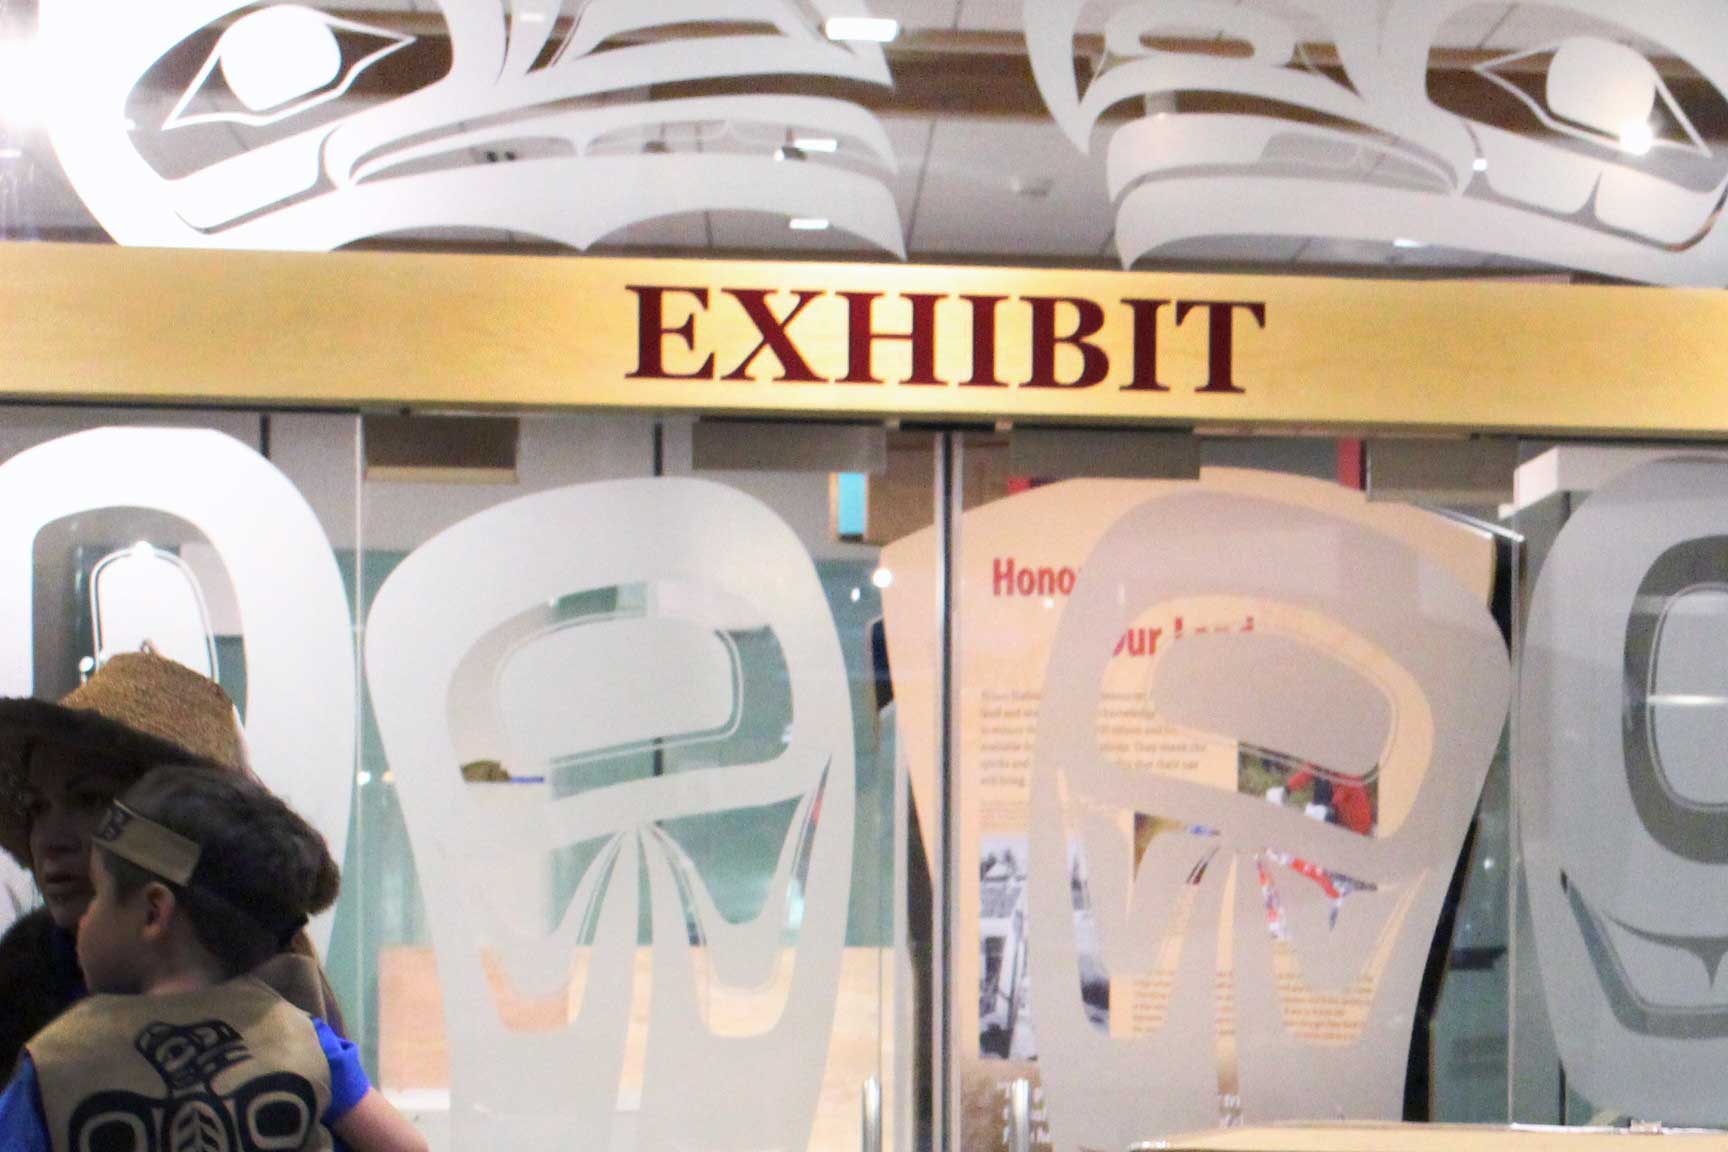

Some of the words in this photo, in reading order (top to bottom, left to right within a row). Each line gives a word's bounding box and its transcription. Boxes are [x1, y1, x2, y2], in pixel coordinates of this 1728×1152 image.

[625, 284, 1266, 394] EXHIBIT
[992, 557, 1081, 597] Hono
[1112, 627, 1162, 658] ur
